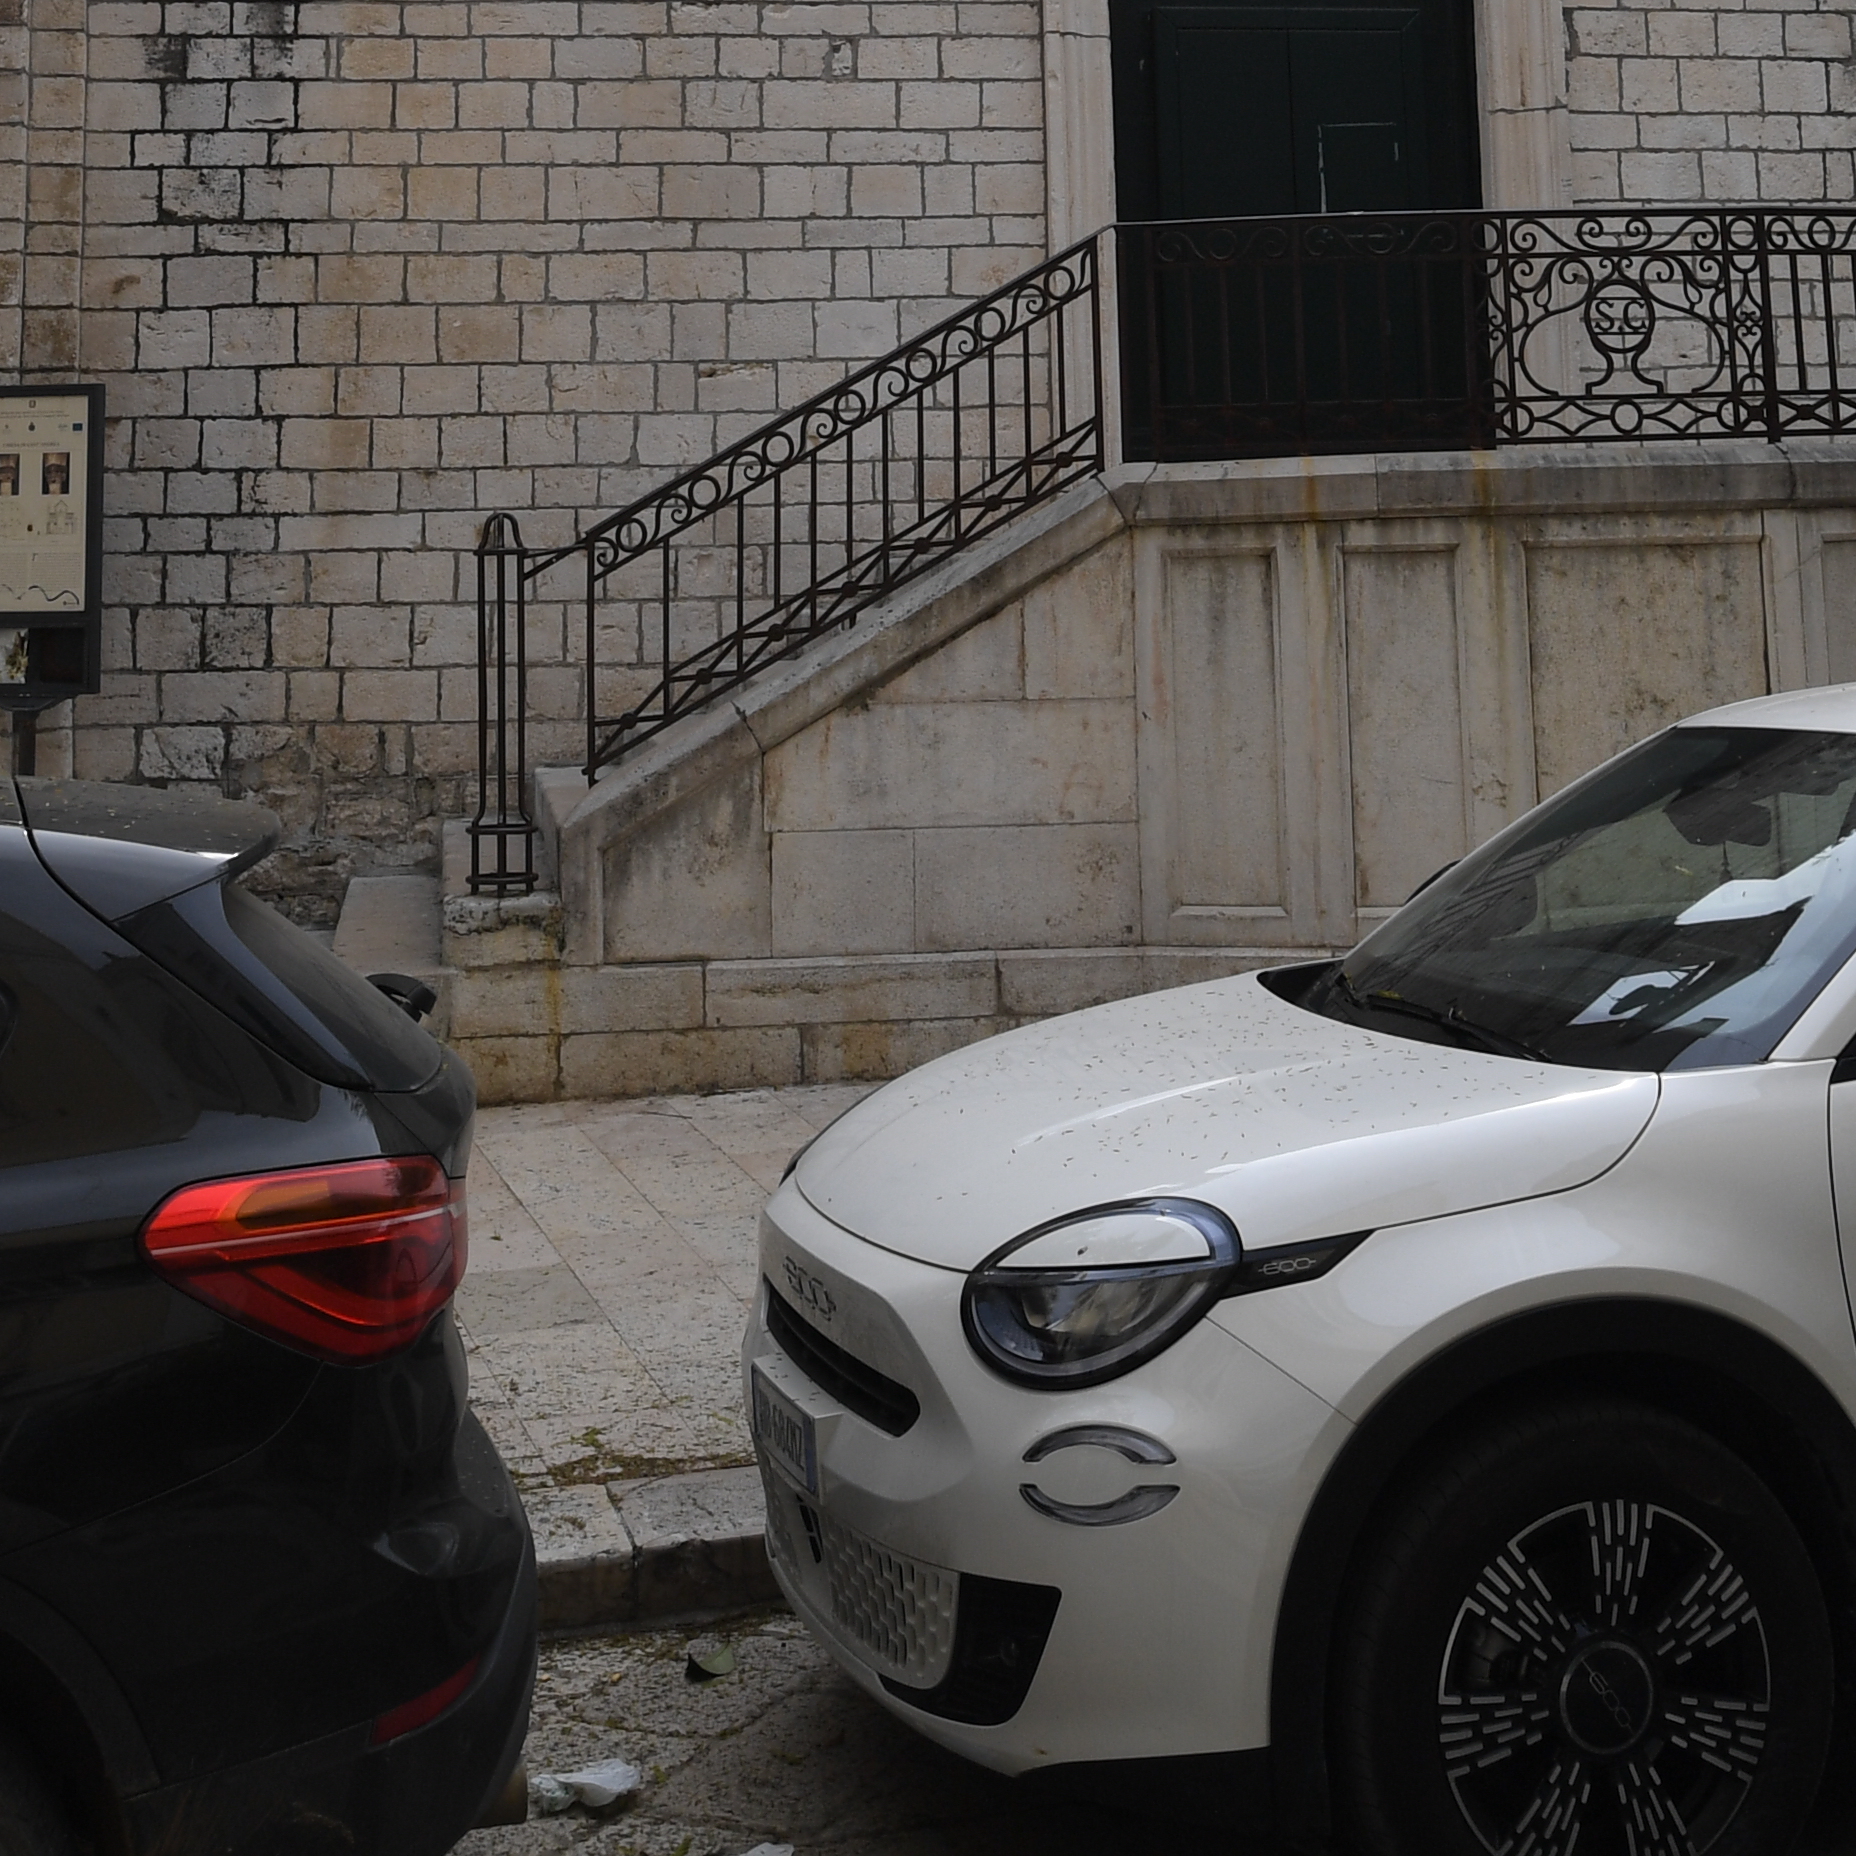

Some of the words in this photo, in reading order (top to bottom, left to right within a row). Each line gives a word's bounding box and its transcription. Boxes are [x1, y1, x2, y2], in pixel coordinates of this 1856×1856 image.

[784, 1256, 836, 1322] 600
[1261, 1257, 1313, 1275] 600
[1589, 1671, 1631, 1728] 600
